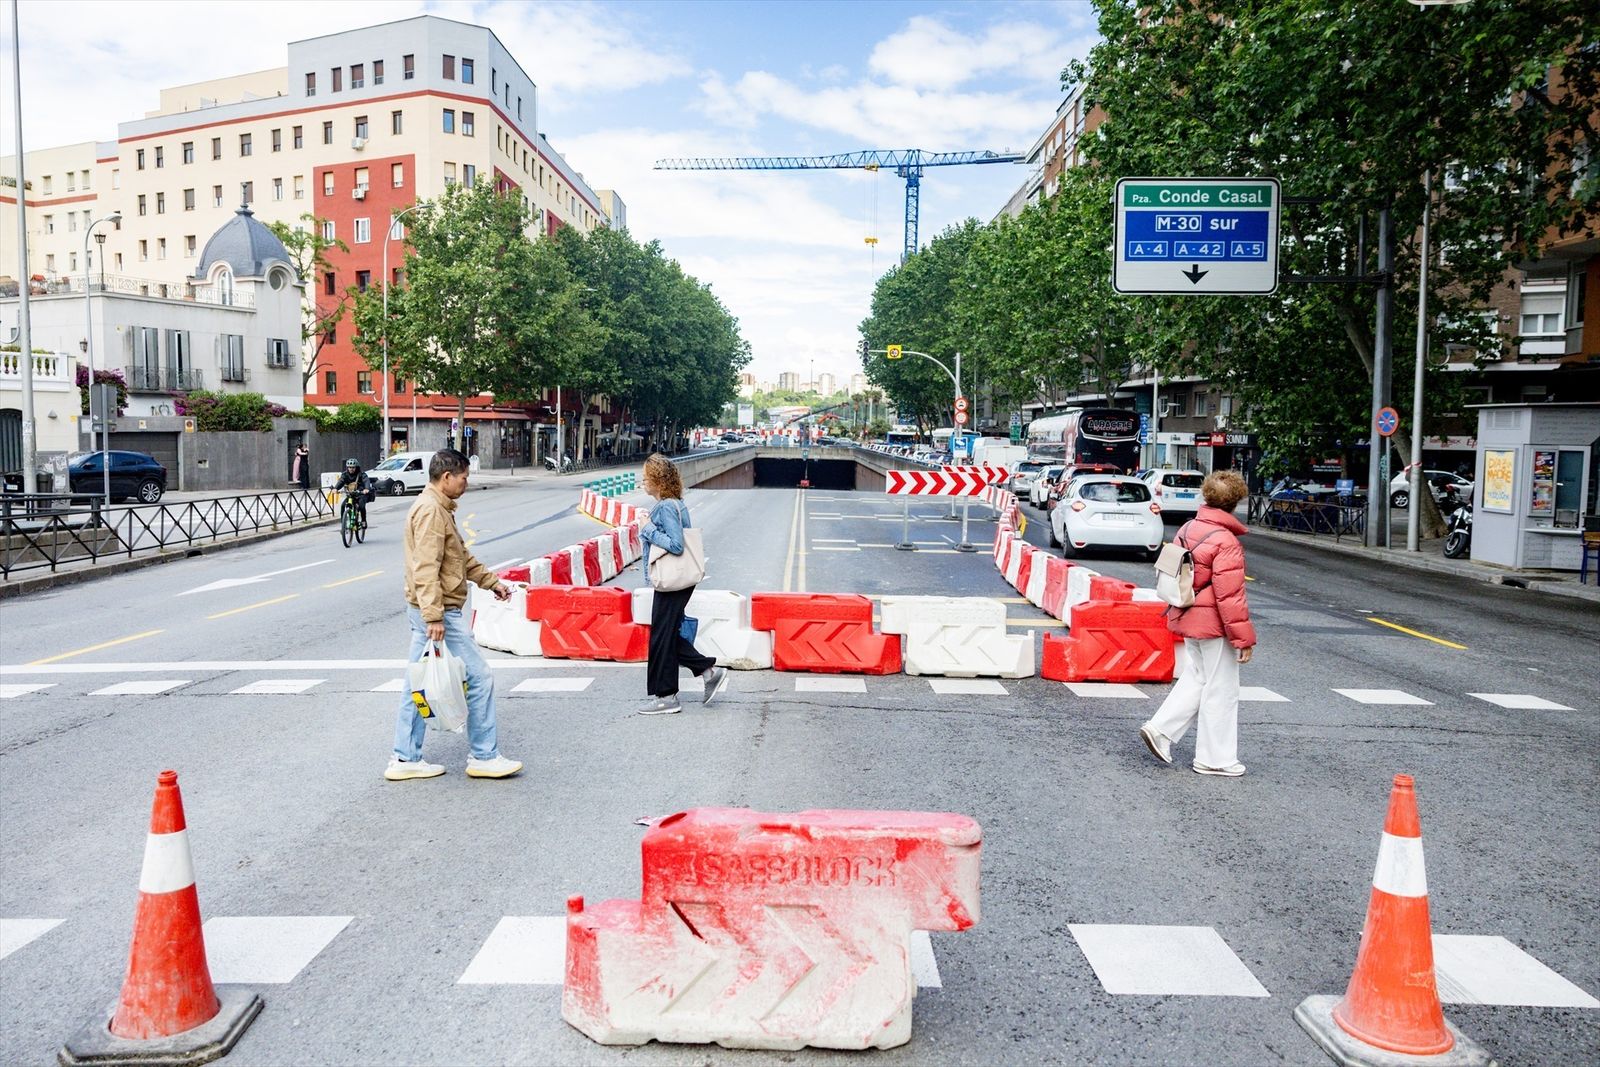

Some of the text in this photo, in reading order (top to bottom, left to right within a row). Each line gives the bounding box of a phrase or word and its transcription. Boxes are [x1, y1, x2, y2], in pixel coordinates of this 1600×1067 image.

[1132, 189, 1263, 203] Pza. Conde Casal
[1157, 216, 1239, 231] M-30 sur
